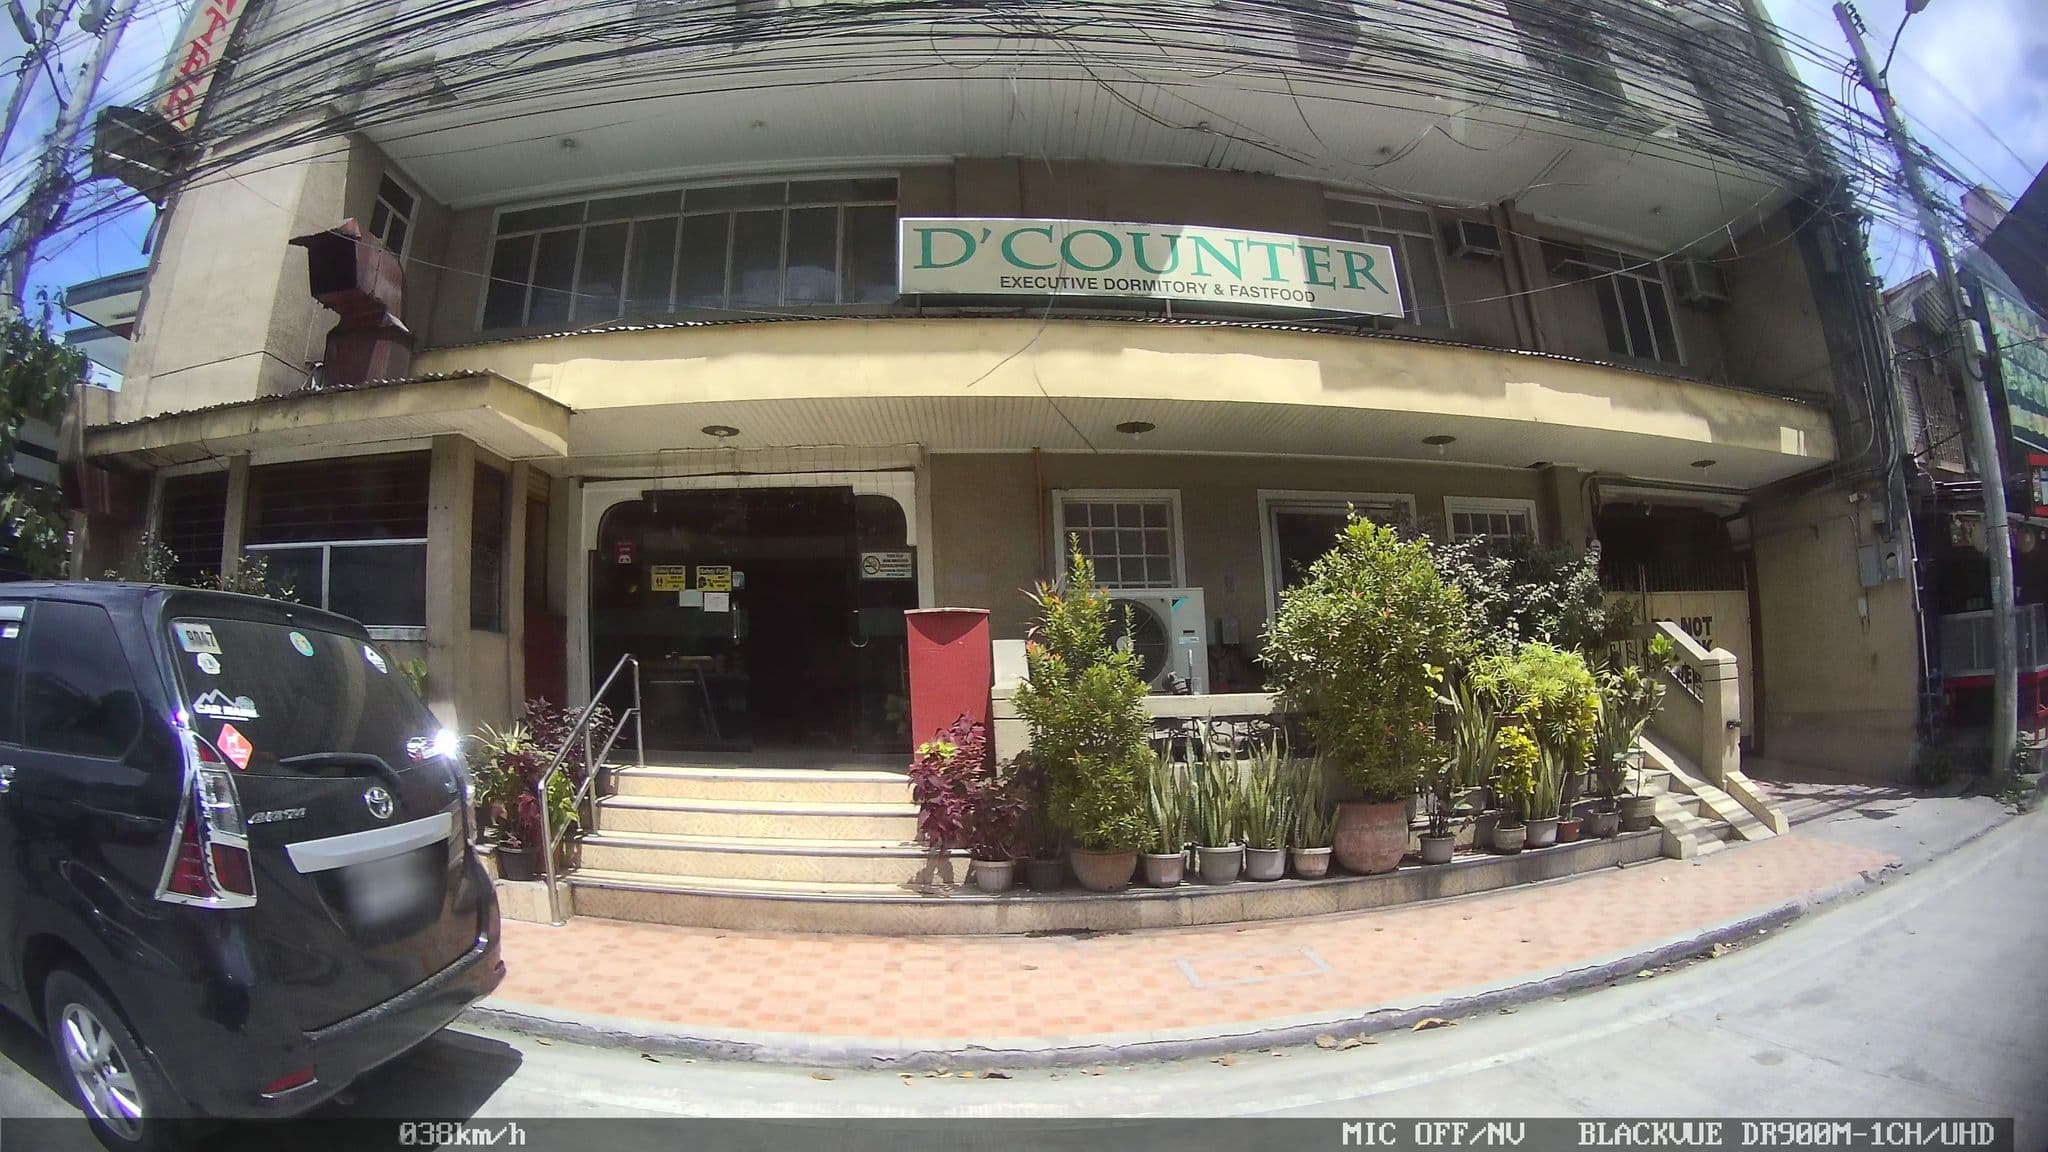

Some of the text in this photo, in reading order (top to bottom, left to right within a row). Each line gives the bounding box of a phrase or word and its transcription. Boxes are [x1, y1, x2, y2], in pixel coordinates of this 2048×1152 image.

[912, 225, 1390, 294] D'COUNTER
[1000, 276, 1316, 303] EXECUTIVE DORMITORY & FASTFOOD
[1680, 616, 1713, 637] NOT
